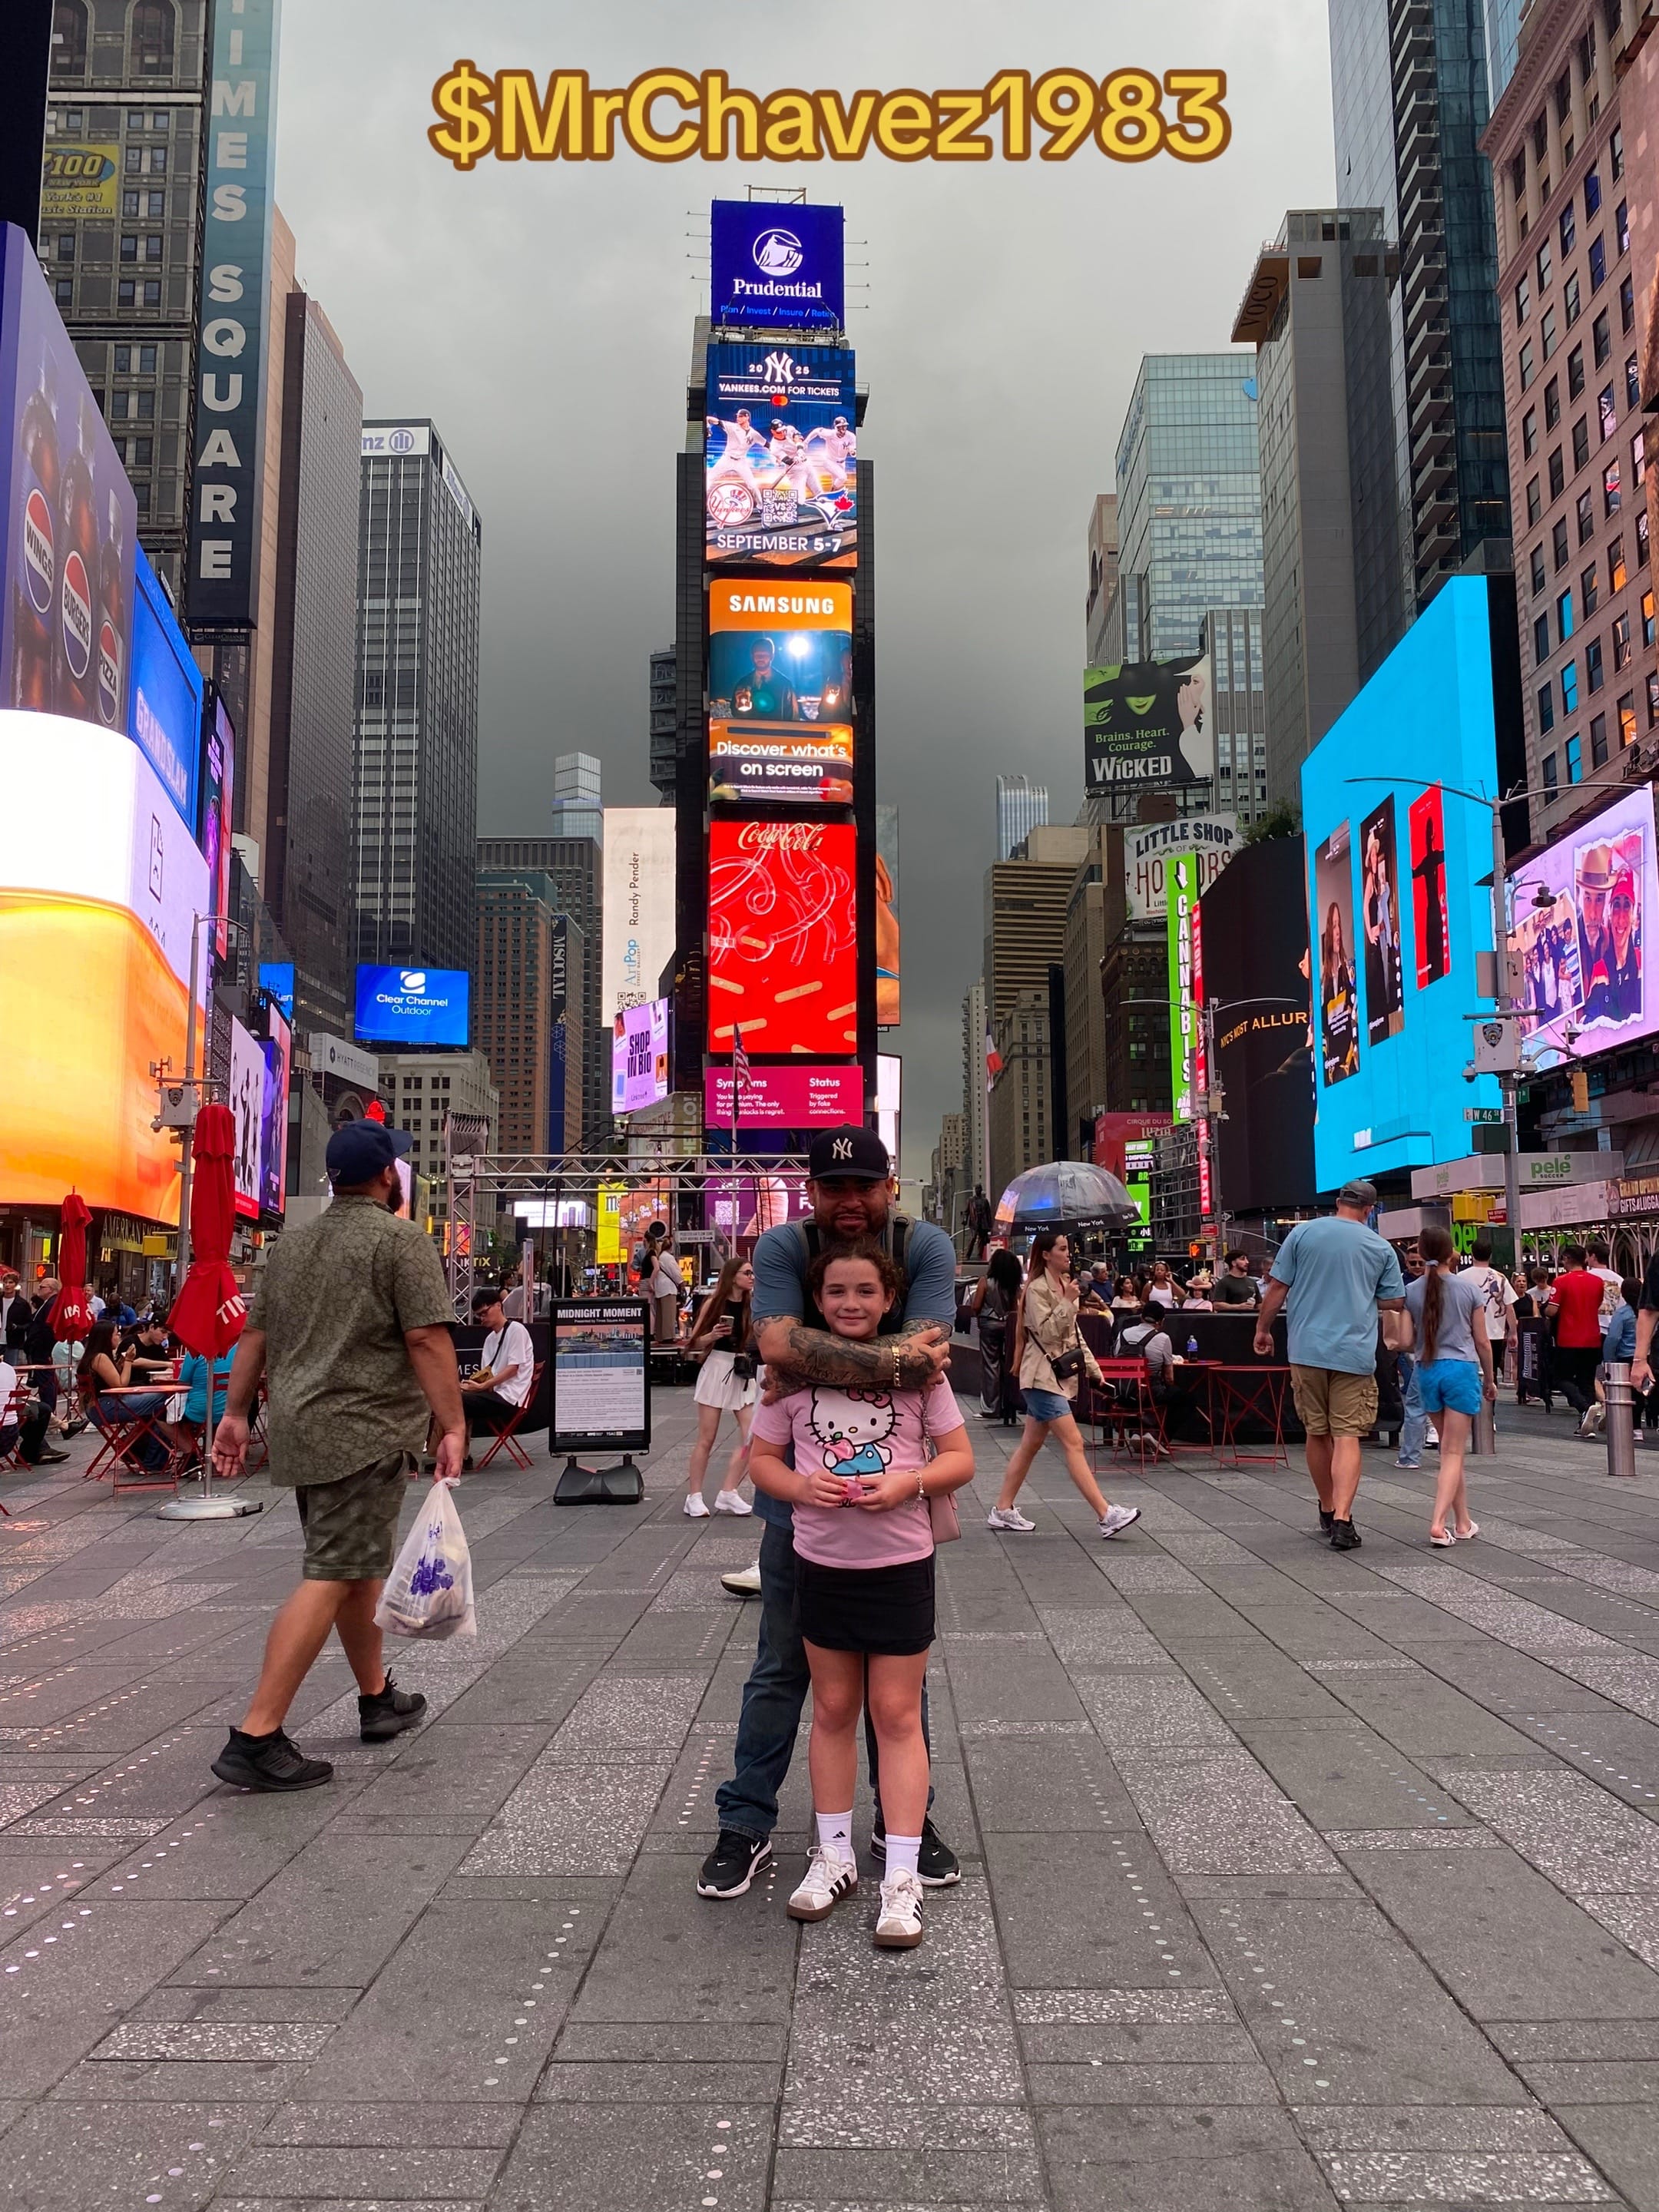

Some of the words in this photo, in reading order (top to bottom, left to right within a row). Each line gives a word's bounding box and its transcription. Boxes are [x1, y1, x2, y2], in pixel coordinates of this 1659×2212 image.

[211, 0, 256, 222] IMES
[44, 152, 103, 176] 100
[68, 203, 112, 214] Station
[733, 278, 823, 298] Prudential
[749, 364, 763, 373] 20
[795, 366, 810, 375] 25
[719, 383, 786, 395] YANKEES.COM
[787, 386, 806, 395] FOR
[807, 387, 839, 396] TICKETS
[198, 264, 247, 579] SQUARE
[775, 502, 786, 511] VS
[26, 519, 54, 583] WINGS
[717, 535, 808, 551] SEPTEMBER
[813, 538, 842, 552] 5-7
[64, 580, 91, 648] BURGERS
[729, 595, 834, 614] SAMSUNG
[1095, 731, 1134, 744] Brains.
[1136, 727, 1170, 740] Heart.
[717, 740, 786, 757] Discover
[792, 743, 846, 758] what's
[1108, 740, 1157, 753] Courage.
[740, 762, 763, 776] on
[766, 763, 823, 777] screen
[1137, 823, 1190, 859] LITTLE
[1193, 822, 1233, 846] SHOP
[628, 852, 640, 889] Pender
[628, 892, 641, 926] Randy
[623, 939, 639, 986] ArtPop
[1178, 894, 1190, 1082] CANNABIS
[376, 994, 405, 1005] Clear
[406, 996, 449, 1007] Channel
[392, 1005, 432, 1016] Outdoor
[1252, 1012, 1308, 1030] ALLUR
[630, 1030, 650, 1056] SHOP
[336, 1055, 353, 1068] HYATT
[628, 1055, 637, 1078] IN
[638, 1051, 651, 1075] BIO
[809, 1078, 840, 1088] Status
[1473, 1109, 1480, 1121] W
[1482, 1110, 1492, 1121] 46
[832, 1137, 853, 1160] NY
[1530, 1154, 1571, 1179] pelé
[1621, 1198, 1636, 1214] GIFTS
[1640, 1194, 1659, 1210] LUGGA
[102, 1214, 142, 1243] AMERICAN
[1460, 1255, 1472, 1265] SOC
[557, 1308, 601, 1319] MIDNIGHT
[603, 1307, 643, 1317] MOMENT
